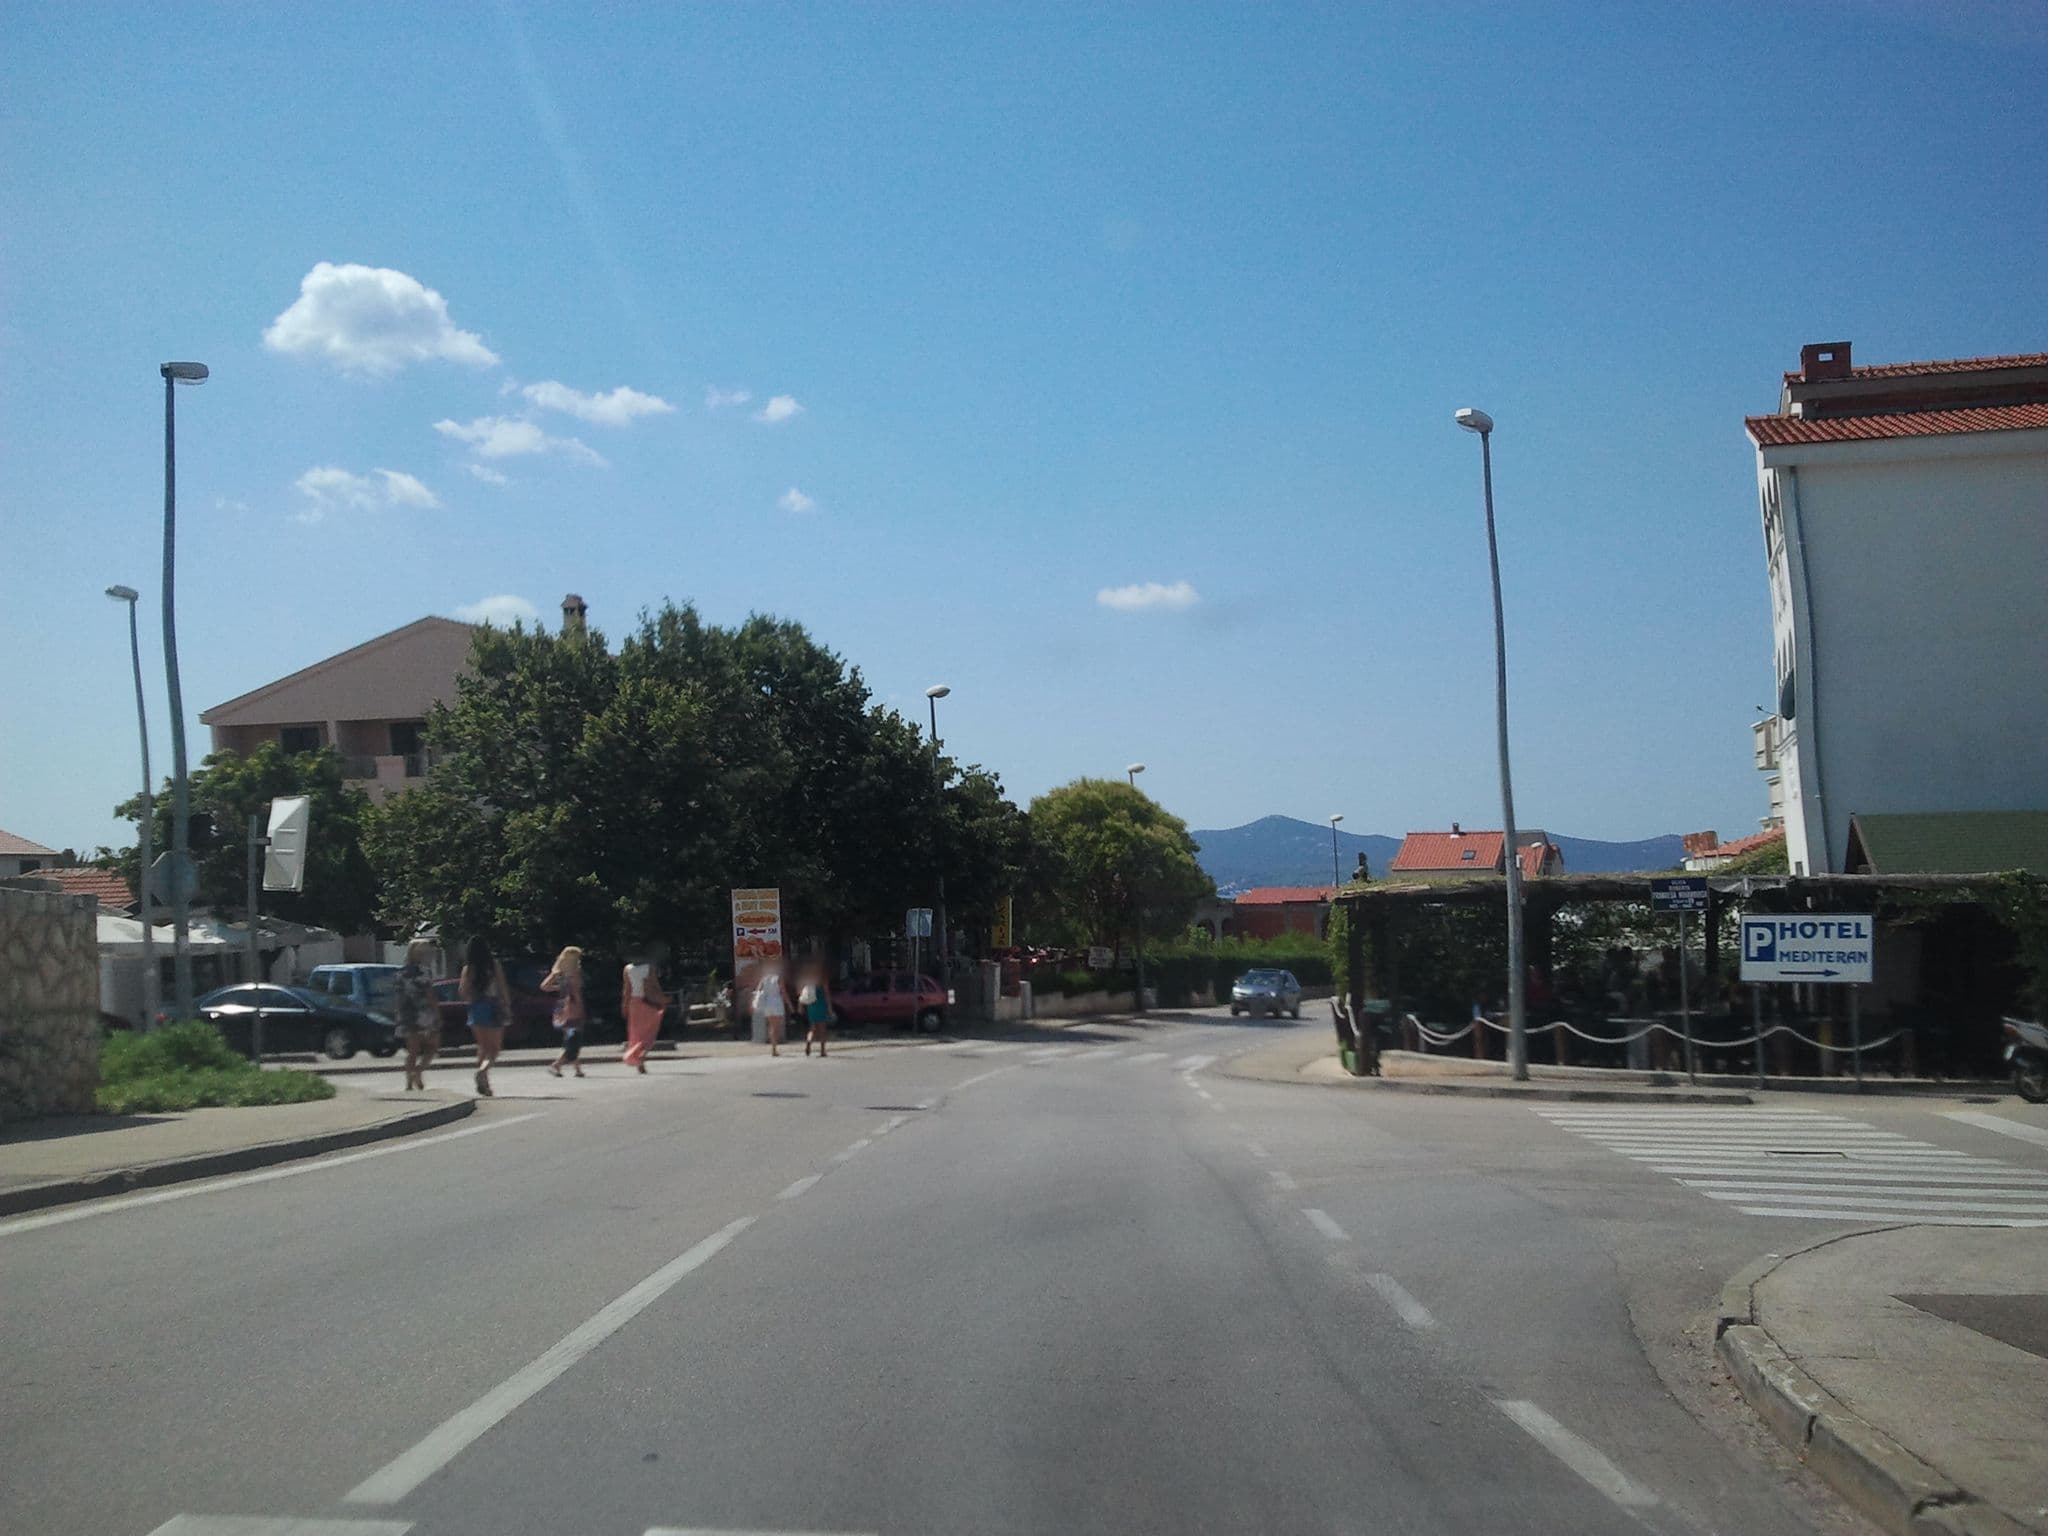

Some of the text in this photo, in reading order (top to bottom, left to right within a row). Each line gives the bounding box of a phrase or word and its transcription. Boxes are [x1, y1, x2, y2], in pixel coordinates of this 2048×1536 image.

[1780, 922, 1868, 940] HOTEL
[1749, 926, 1773, 958] P
[1780, 950, 1868, 963] MEDITERAN
